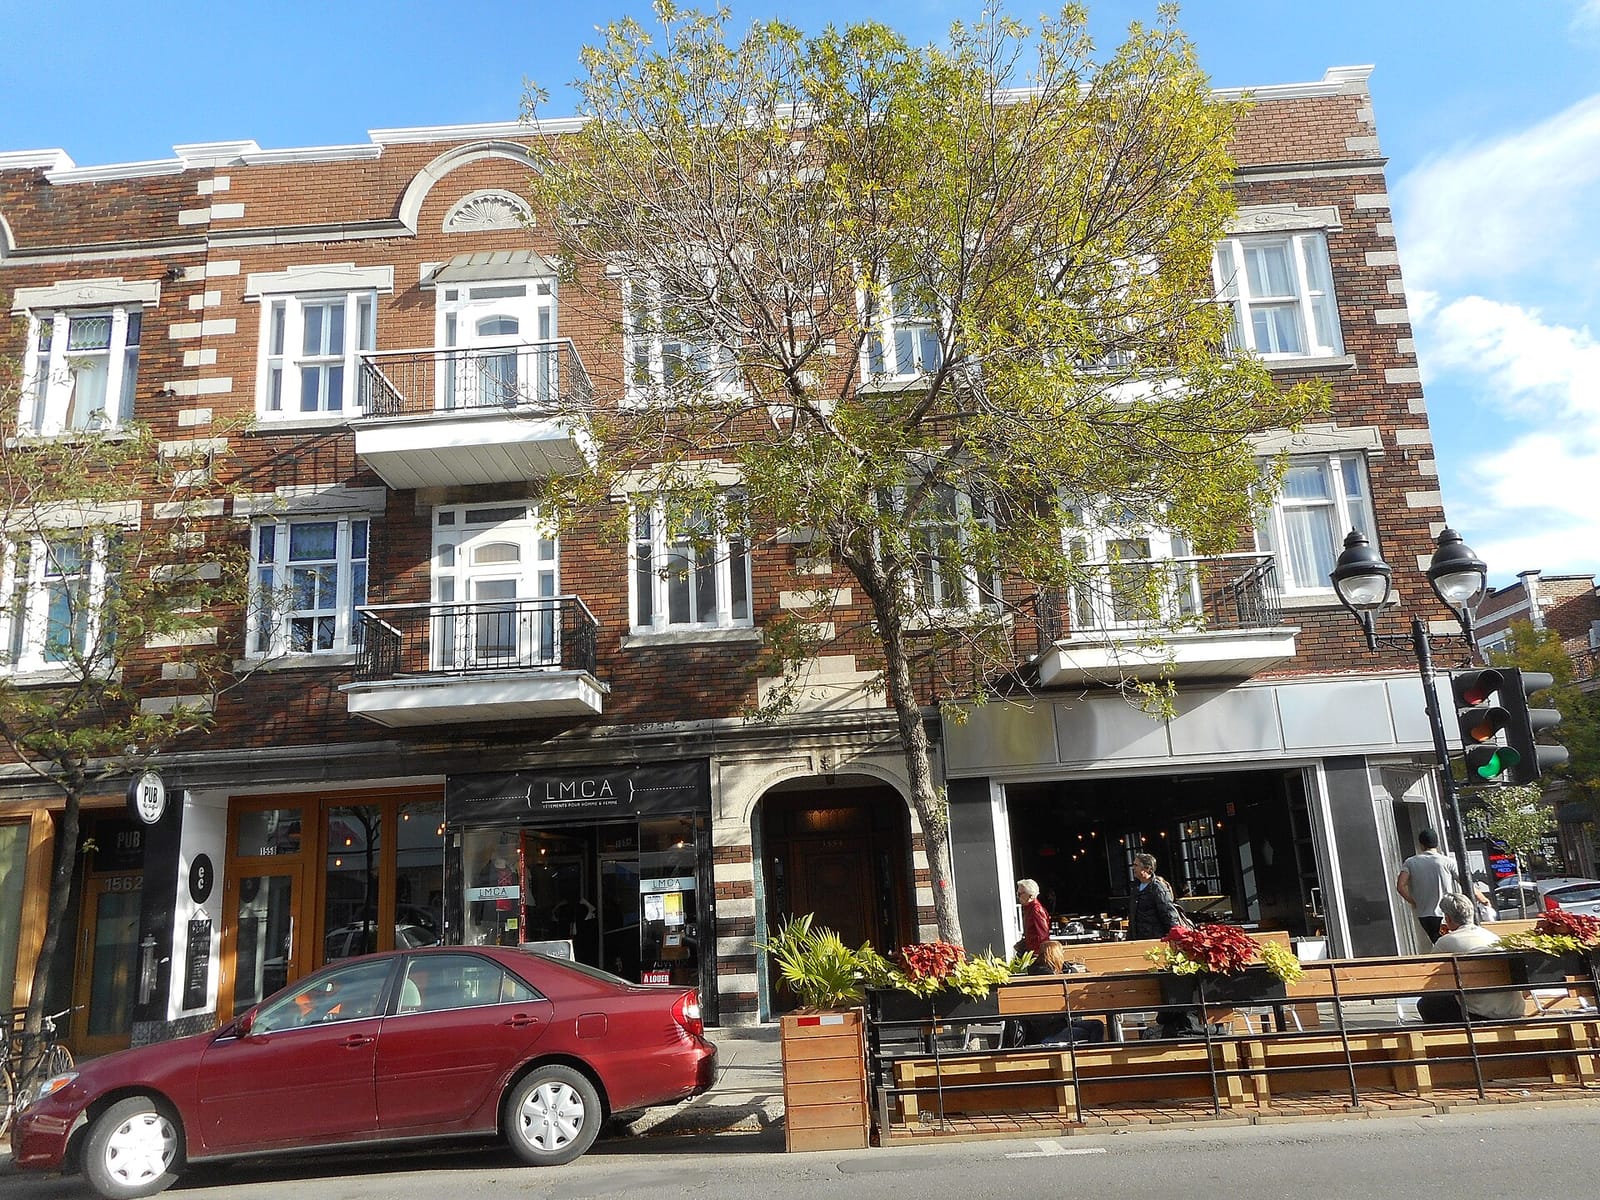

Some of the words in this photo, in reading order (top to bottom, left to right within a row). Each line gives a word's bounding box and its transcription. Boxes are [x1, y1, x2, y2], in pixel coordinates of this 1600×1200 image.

[143, 786, 158, 803] PUB
[546, 779, 613, 800] LMCA
[117, 831, 141, 848] PUB
[104, 876, 144, 892] 1562
[479, 887, 508, 897] LMCA
[652, 879, 681, 889] LMCA
[649, 975, 669, 983] LOUER
